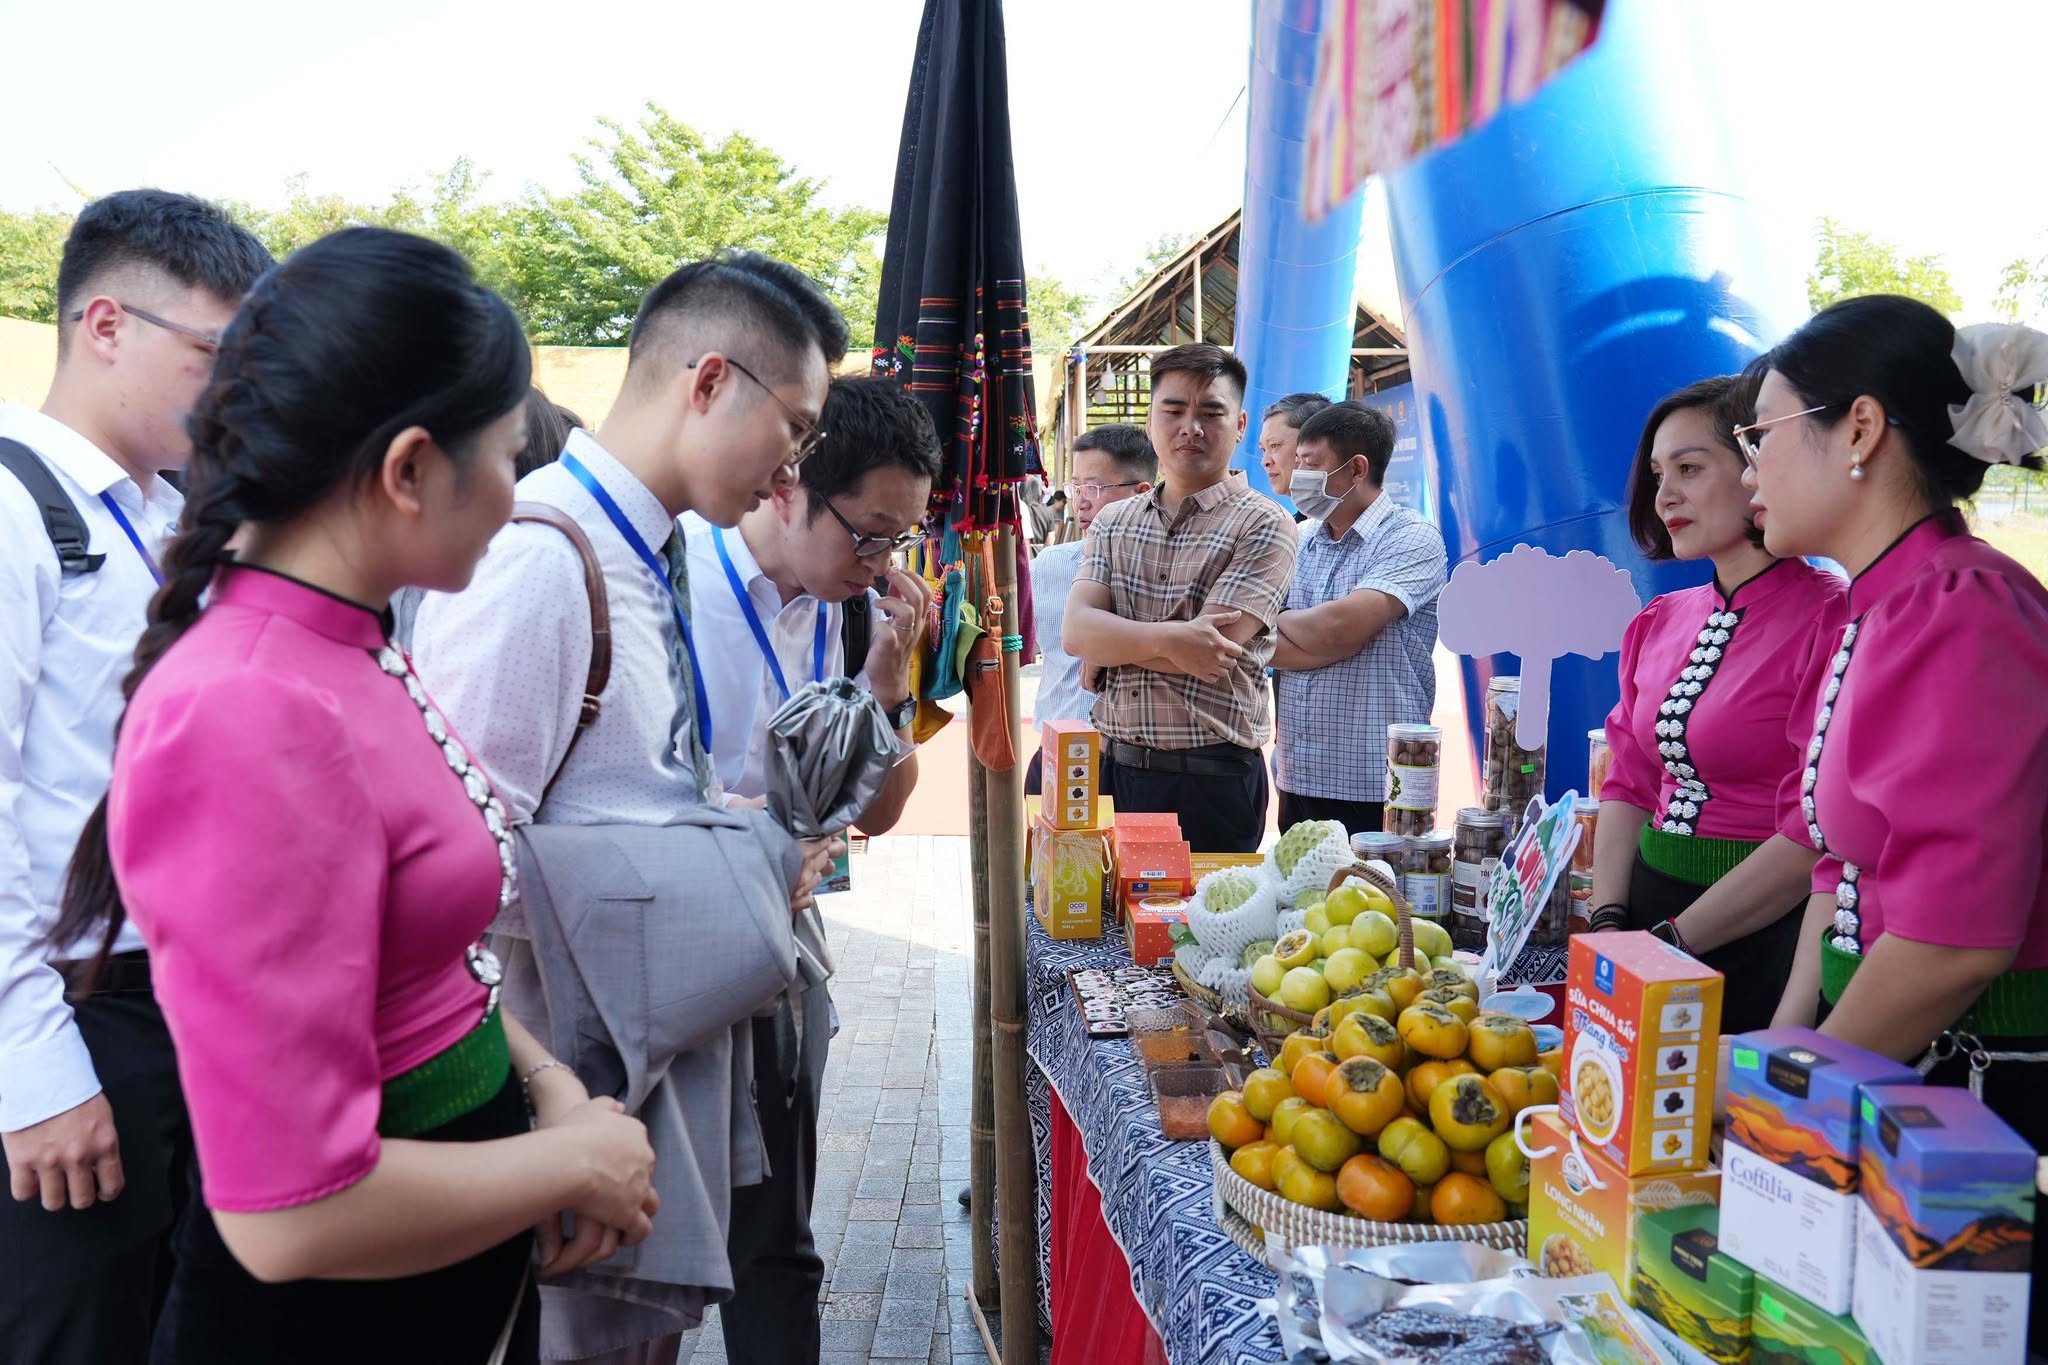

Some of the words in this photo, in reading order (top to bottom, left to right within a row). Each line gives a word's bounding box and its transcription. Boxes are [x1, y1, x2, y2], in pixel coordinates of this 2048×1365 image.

[1589, 999, 1616, 1029] CHUA
[1730, 1156, 1793, 1204] Coffilia
[1544, 1181, 1573, 1213] LONG
